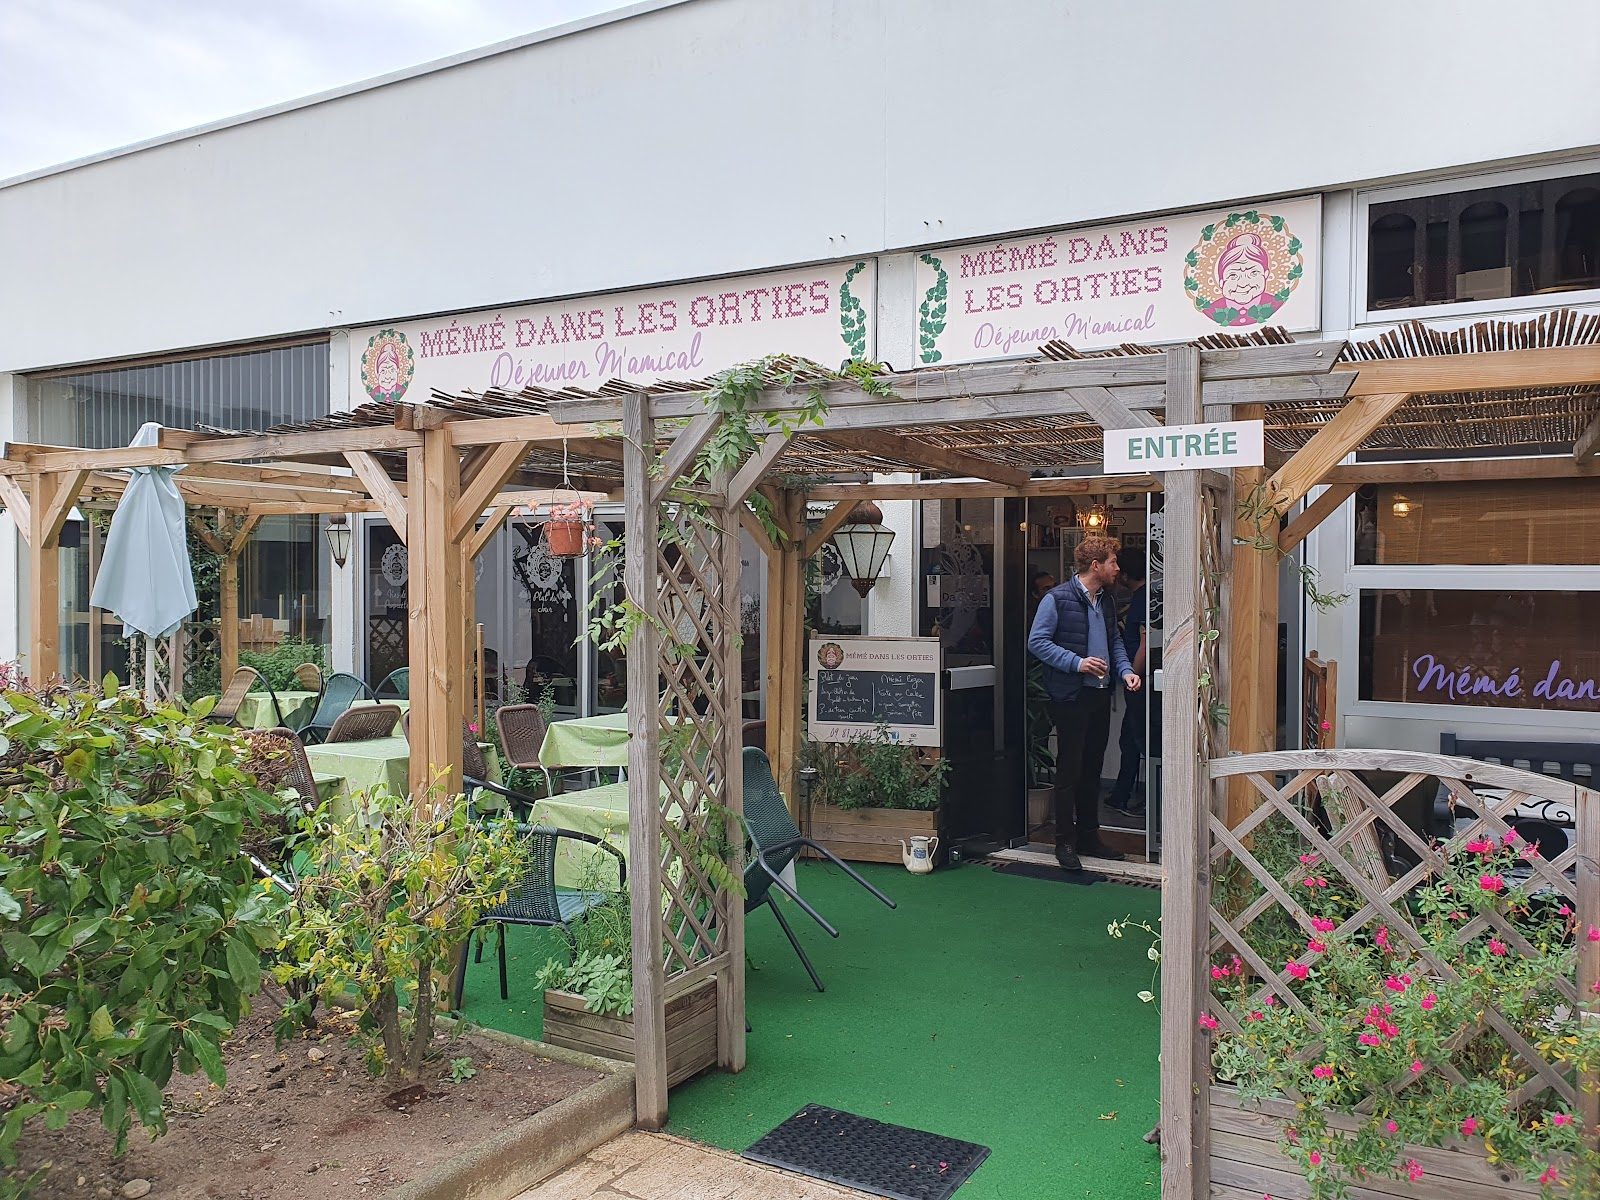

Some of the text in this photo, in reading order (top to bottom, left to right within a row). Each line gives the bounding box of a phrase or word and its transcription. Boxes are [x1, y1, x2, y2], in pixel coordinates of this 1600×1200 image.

[960, 226, 1168, 279] MÉMÉ DANS
[964, 266, 1162, 314] LES ORTIES
[420, 280, 829, 358] MÉMÉ DANS LES ORTIES
[974, 304, 1156, 354] Déjeuner M'amical
[490, 331, 704, 387] Déjeuner M'amical
[1128, 427, 1238, 460] ENTRÉE
[846, 652, 868, 660] MÉMÉ
[869, 653, 890, 661] DANS
[891, 653, 905, 661] LES
[1412, 654, 1600, 700] Mémé dan
